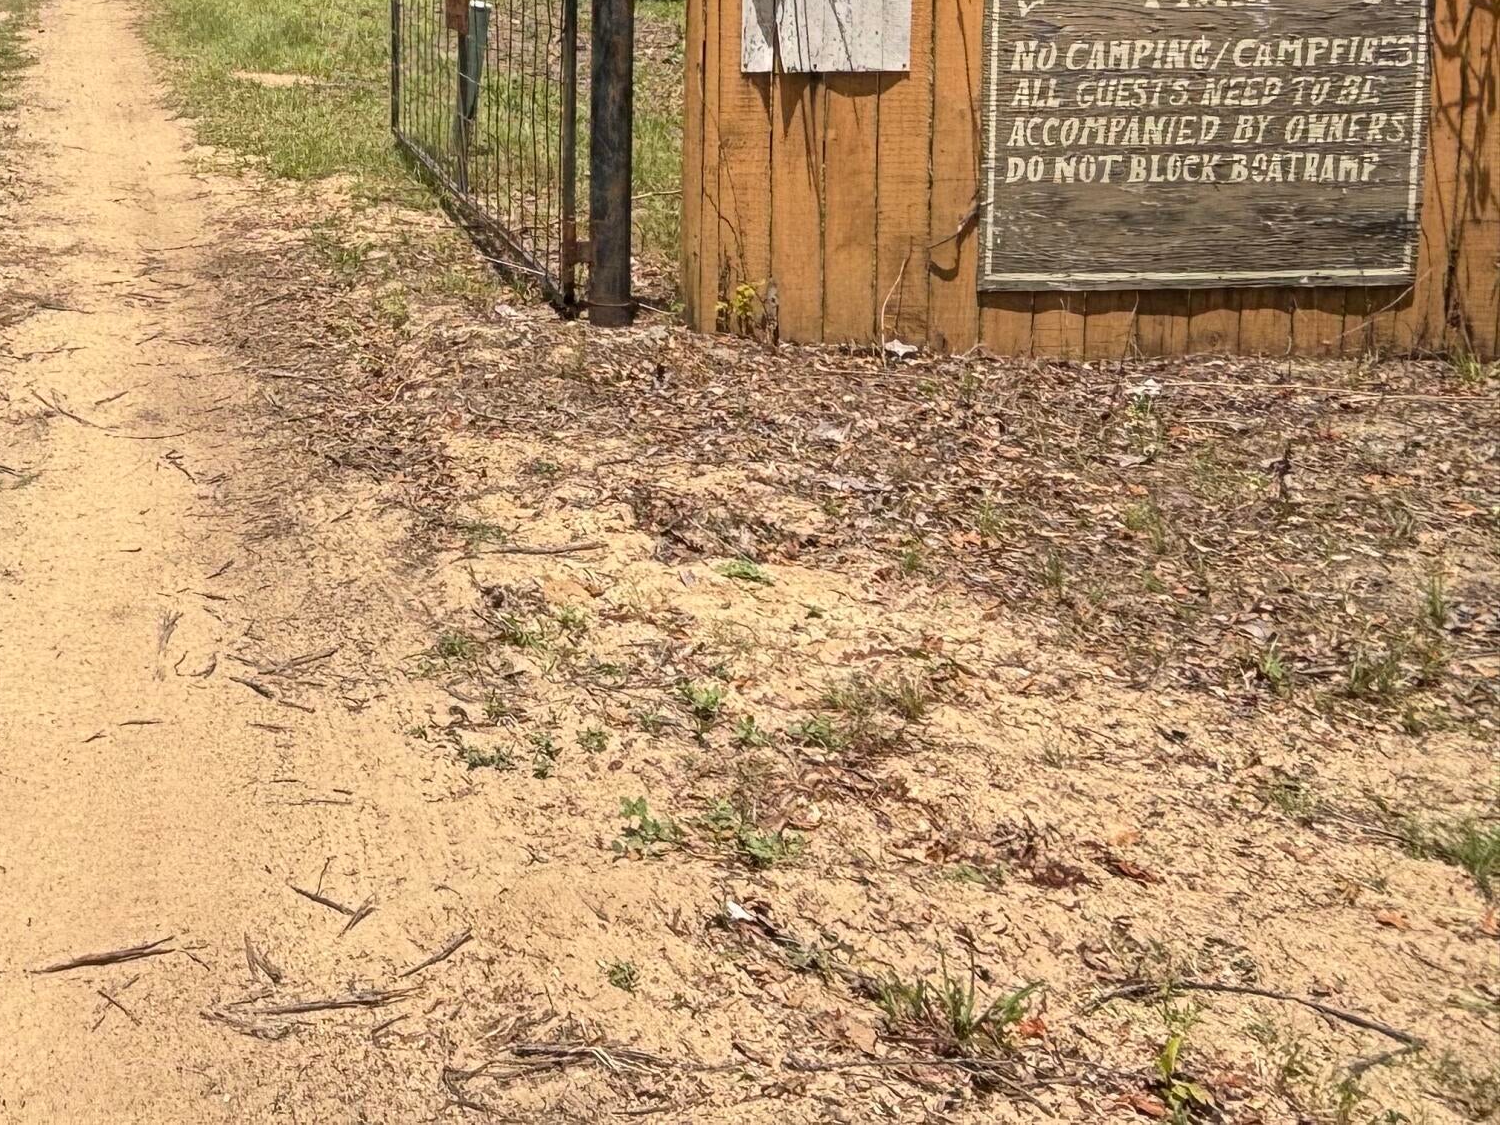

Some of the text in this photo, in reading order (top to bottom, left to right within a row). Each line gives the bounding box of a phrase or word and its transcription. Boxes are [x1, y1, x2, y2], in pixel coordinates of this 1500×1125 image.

[1011, 40, 1058, 71] NO
[1010, 78, 1061, 107] ALL
[1200, 76, 1283, 106] NEED
[1291, 77, 1332, 106] TO
[1335, 75, 1387, 105] BE
[1006, 115, 1220, 146] ACCOMPANIED
[1231, 114, 1277, 143] BY
[1005, 156, 1045, 184] DO
[1052, 155, 1123, 184] NOT
[1126, 153, 1221, 183] BLOCK
